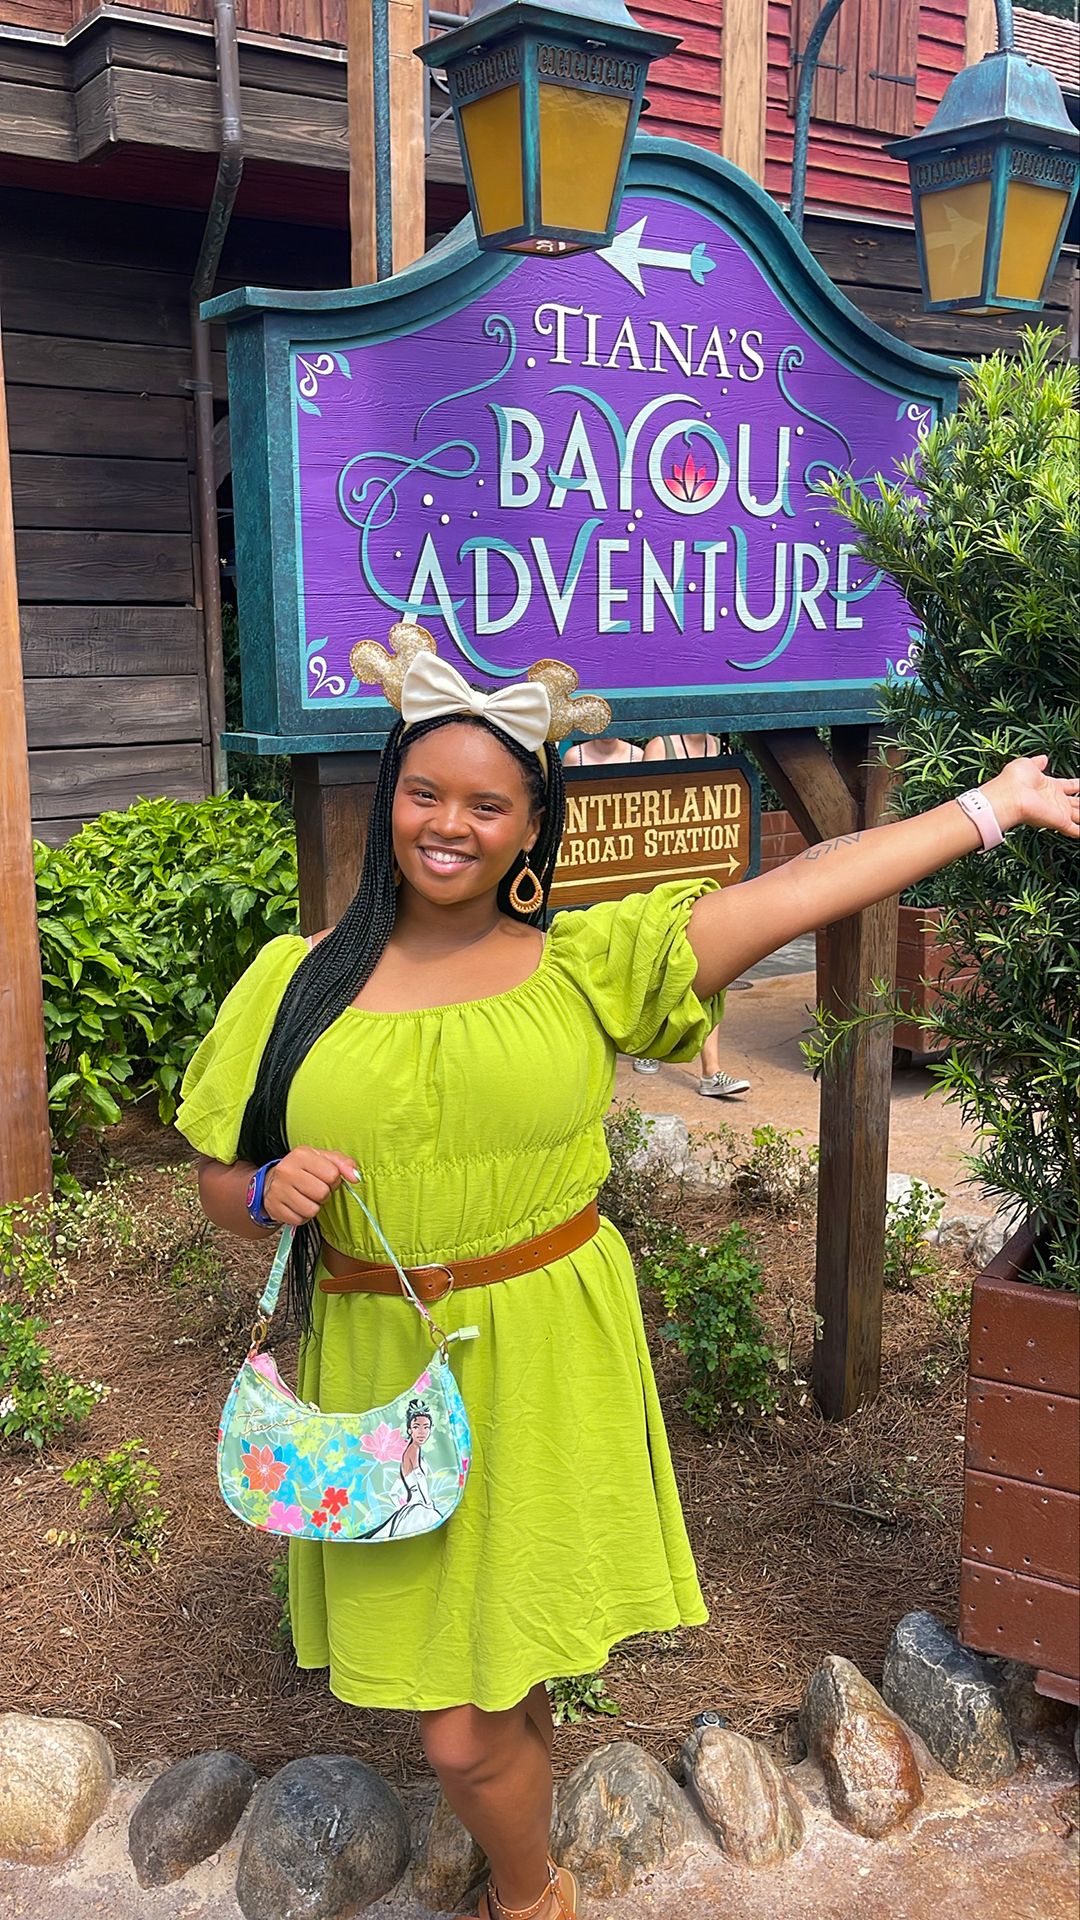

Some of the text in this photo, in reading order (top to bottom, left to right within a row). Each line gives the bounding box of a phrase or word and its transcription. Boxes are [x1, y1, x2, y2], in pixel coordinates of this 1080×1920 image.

[533, 303, 764, 382] TIANA'S
[488, 385, 797, 517] BAYOU
[400, 518, 884, 677] ADVENTURE
[564, 783, 742, 834] NTIERLAND
[554, 824, 741, 868] LROAD STATION
[235, 1408, 304, 1440] Tiana
